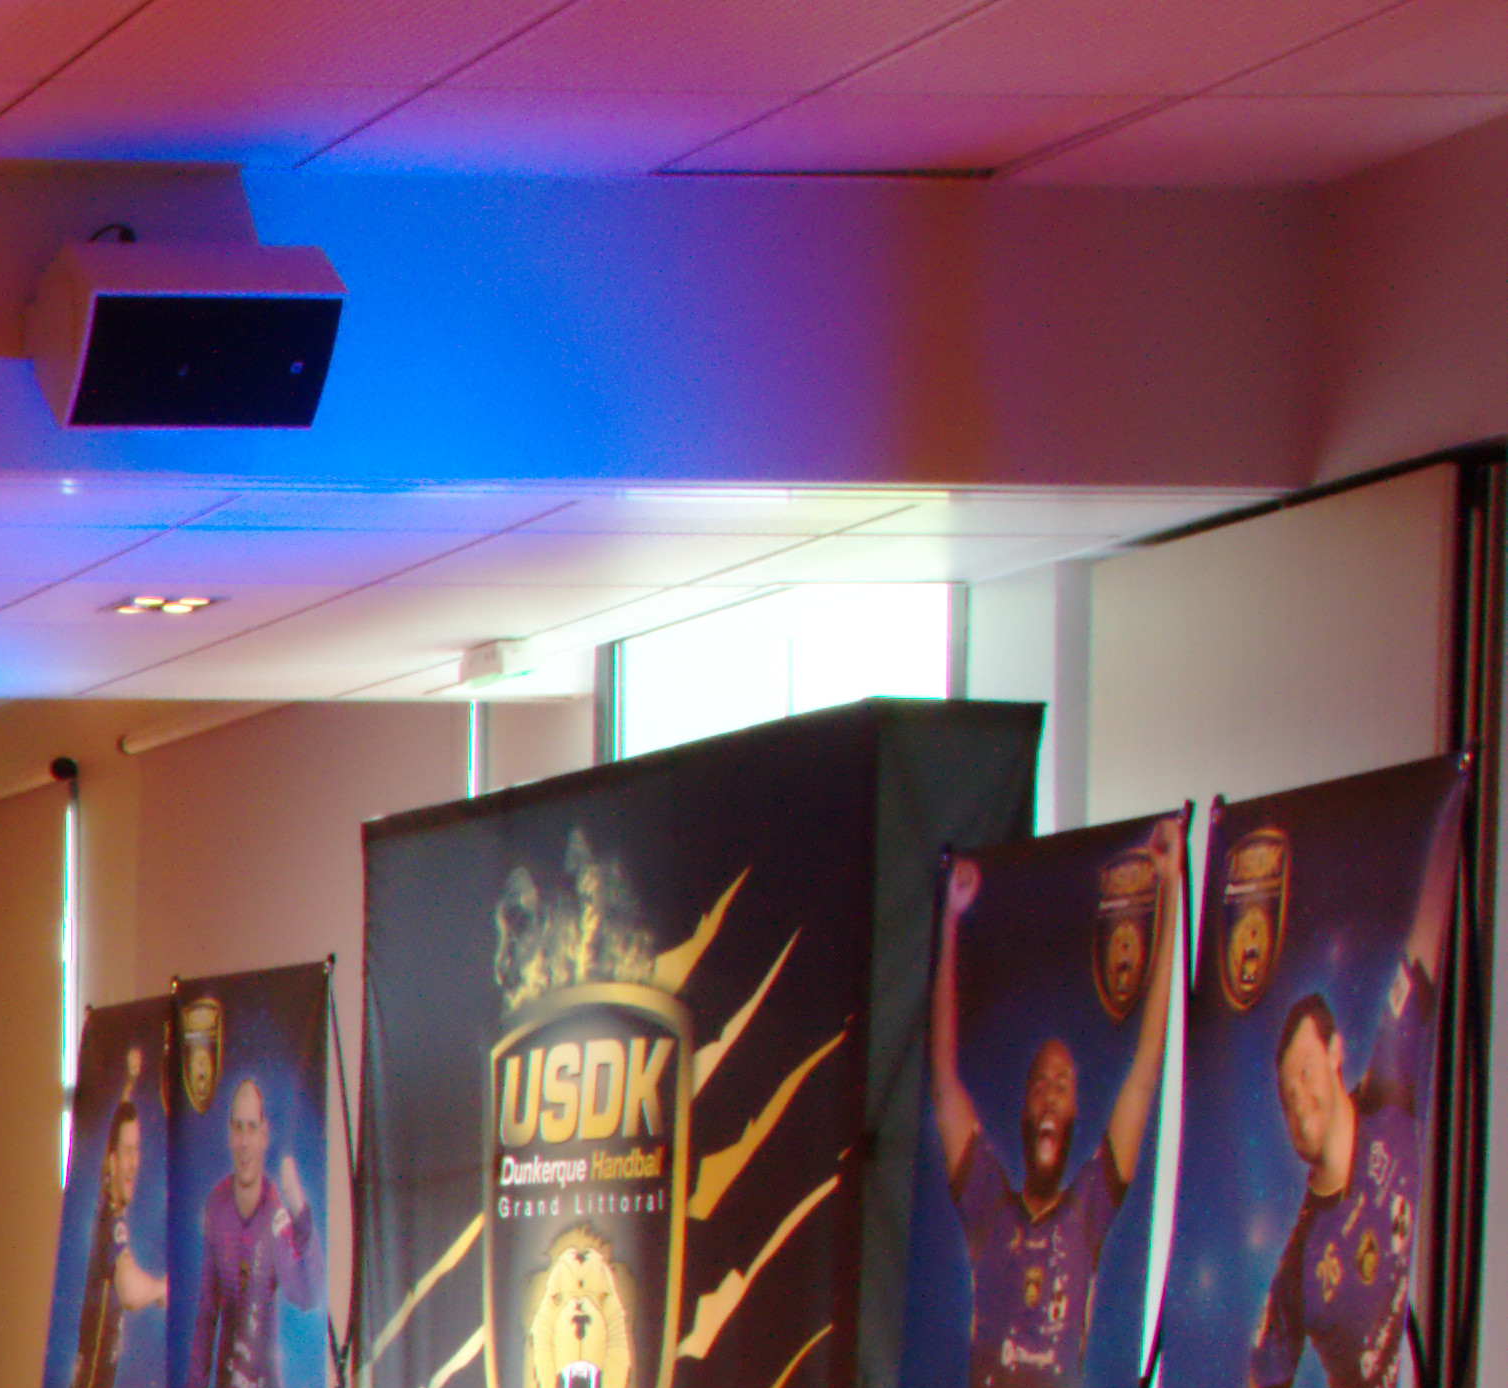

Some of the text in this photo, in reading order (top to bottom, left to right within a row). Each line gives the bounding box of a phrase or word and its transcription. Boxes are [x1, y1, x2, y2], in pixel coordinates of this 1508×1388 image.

[500, 1037, 675, 1147] USDK
[500, 1156, 589, 1188] Dunkerque
[498, 1188, 665, 1218] Grand Littoral
